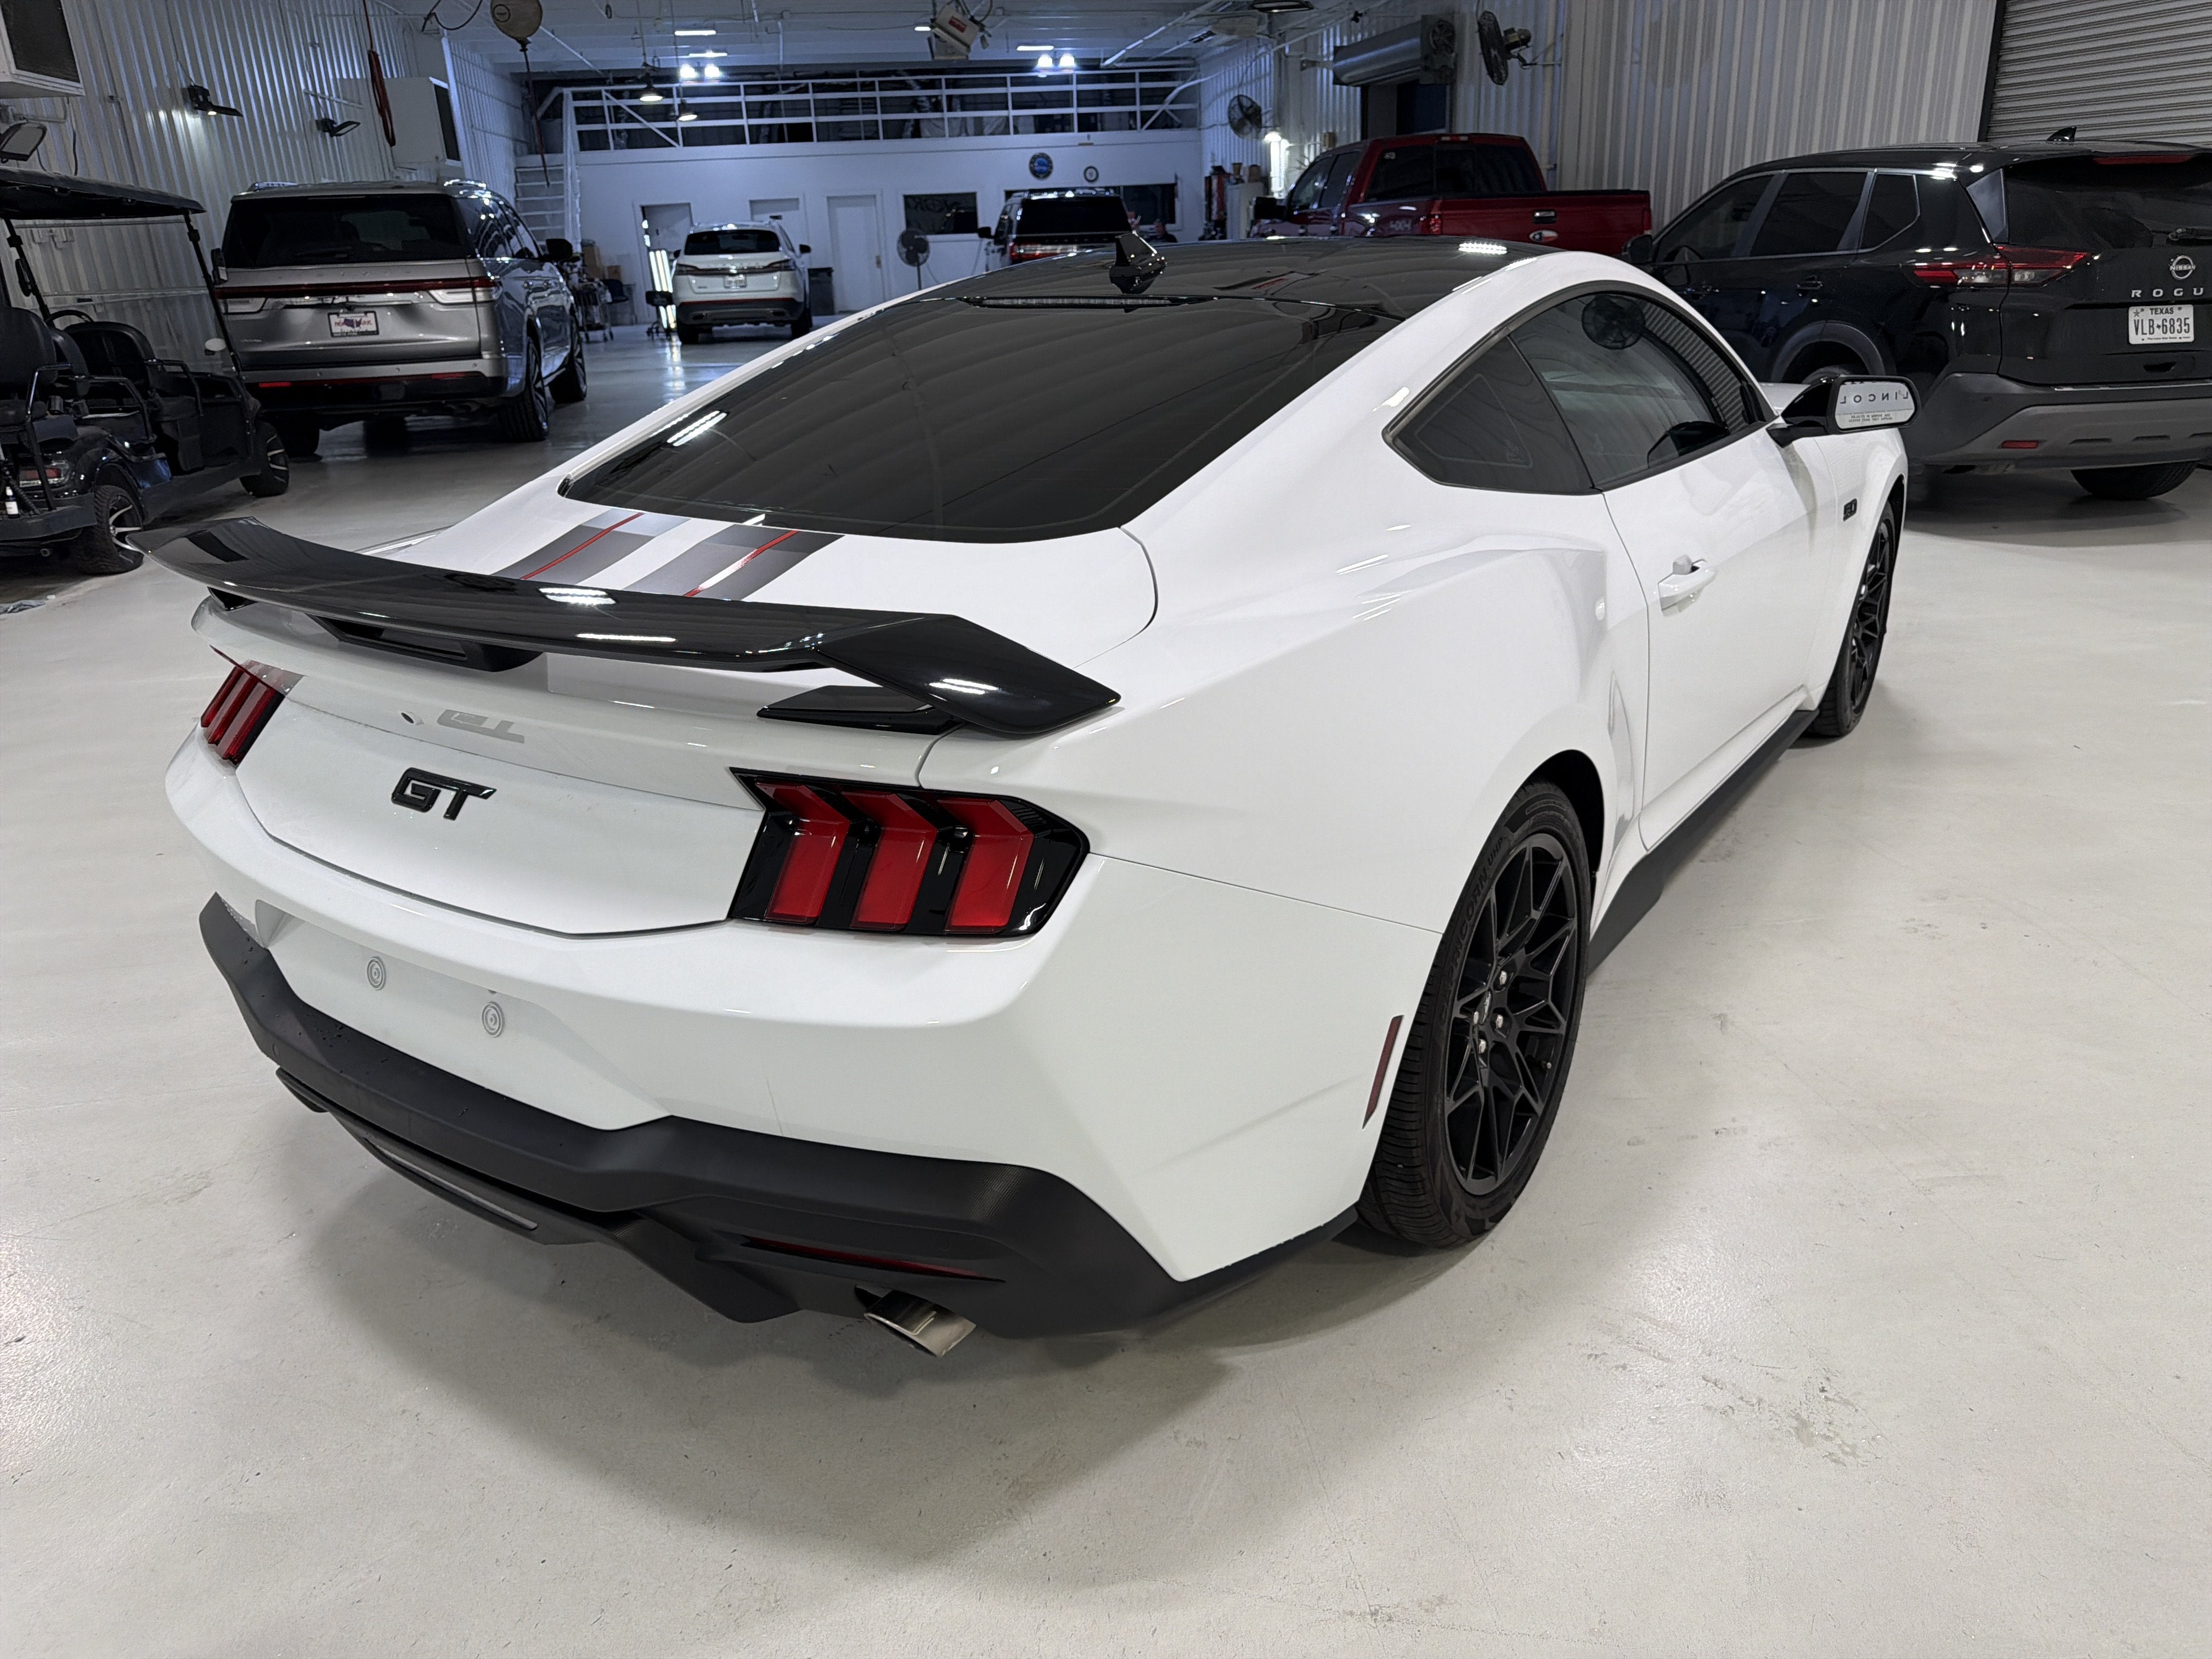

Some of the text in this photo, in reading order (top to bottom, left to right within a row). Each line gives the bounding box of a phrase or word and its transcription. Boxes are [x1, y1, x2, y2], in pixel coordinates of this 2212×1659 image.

[2131, 287, 2204, 298] ROGU
[391, 767, 497, 821] GT
[1487, 837, 1503, 866] UHP
